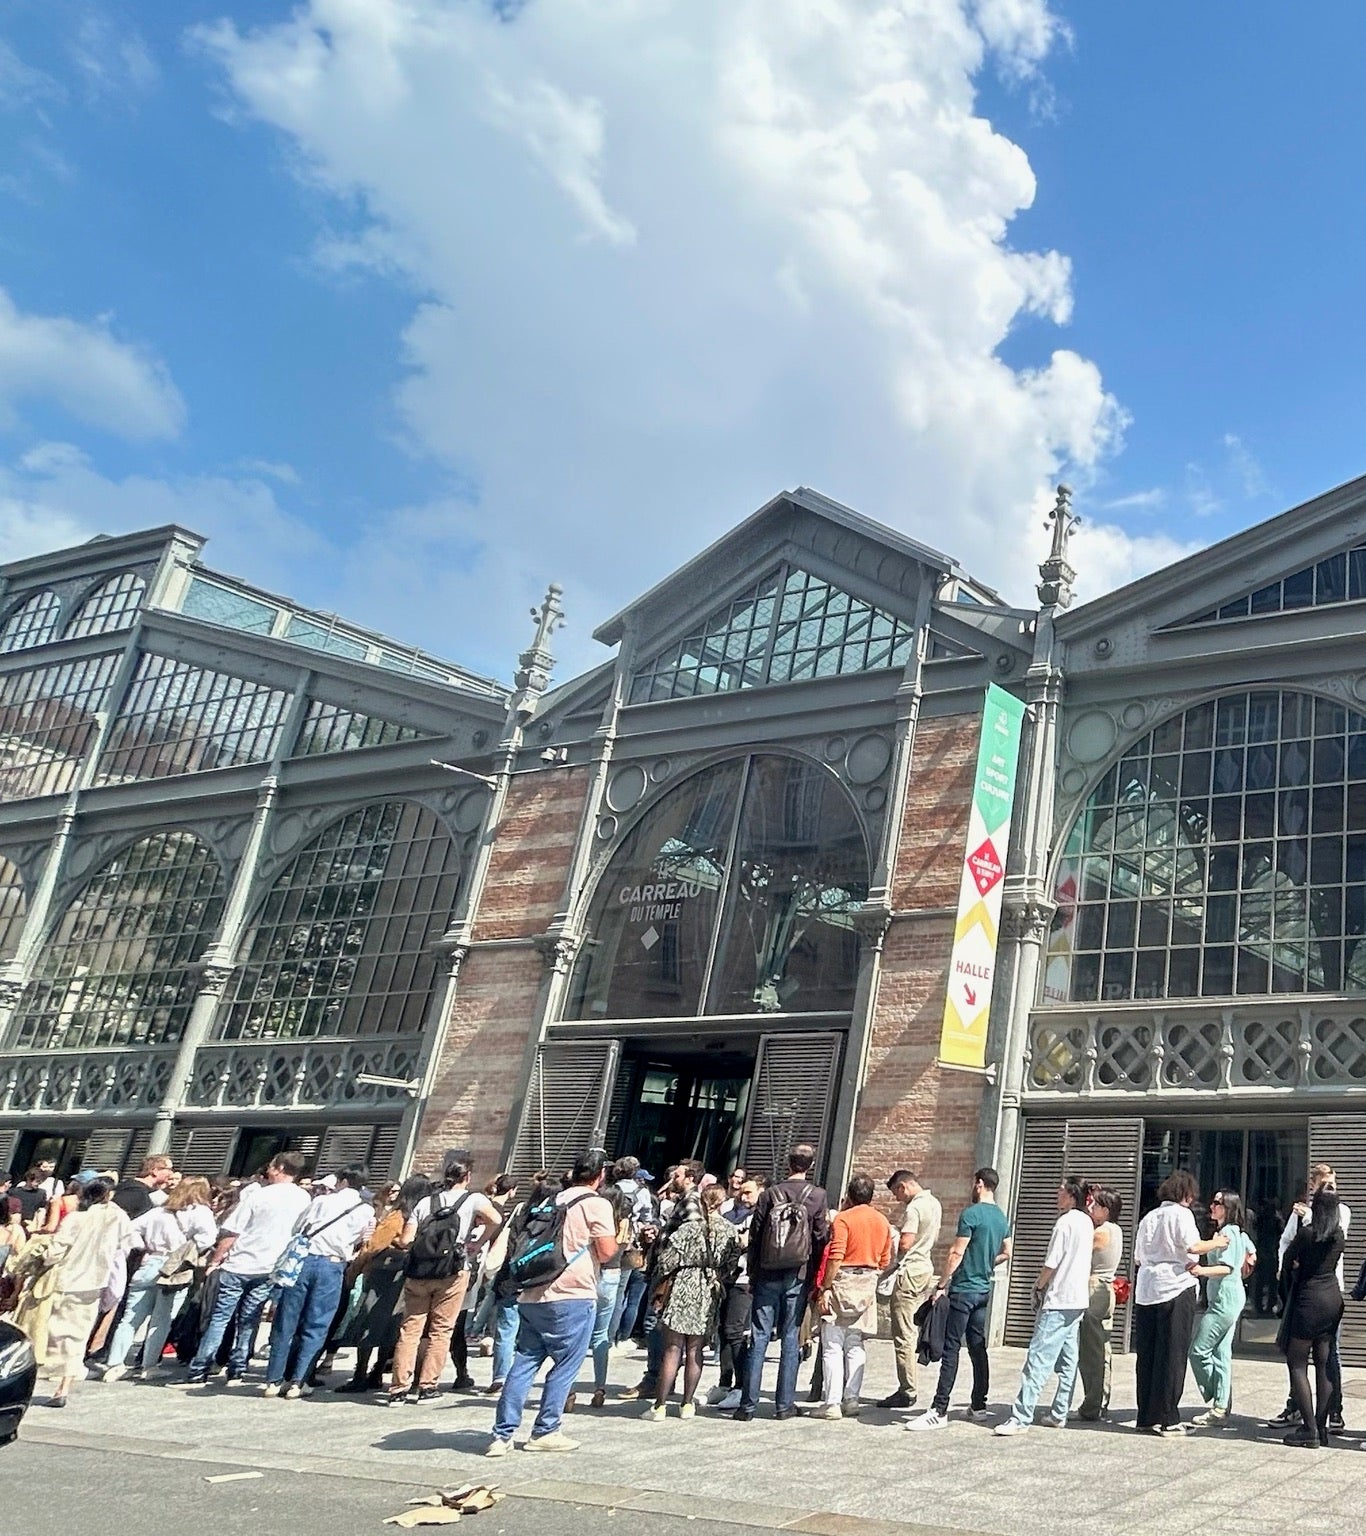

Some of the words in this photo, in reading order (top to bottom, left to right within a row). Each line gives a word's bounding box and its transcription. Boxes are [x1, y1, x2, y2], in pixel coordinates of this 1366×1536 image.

[619, 882, 701, 904] CARREAU
[630, 905, 644, 922] DU
[645, 903, 681, 921] TEMPLE
[956, 960, 991, 980] HALLE
